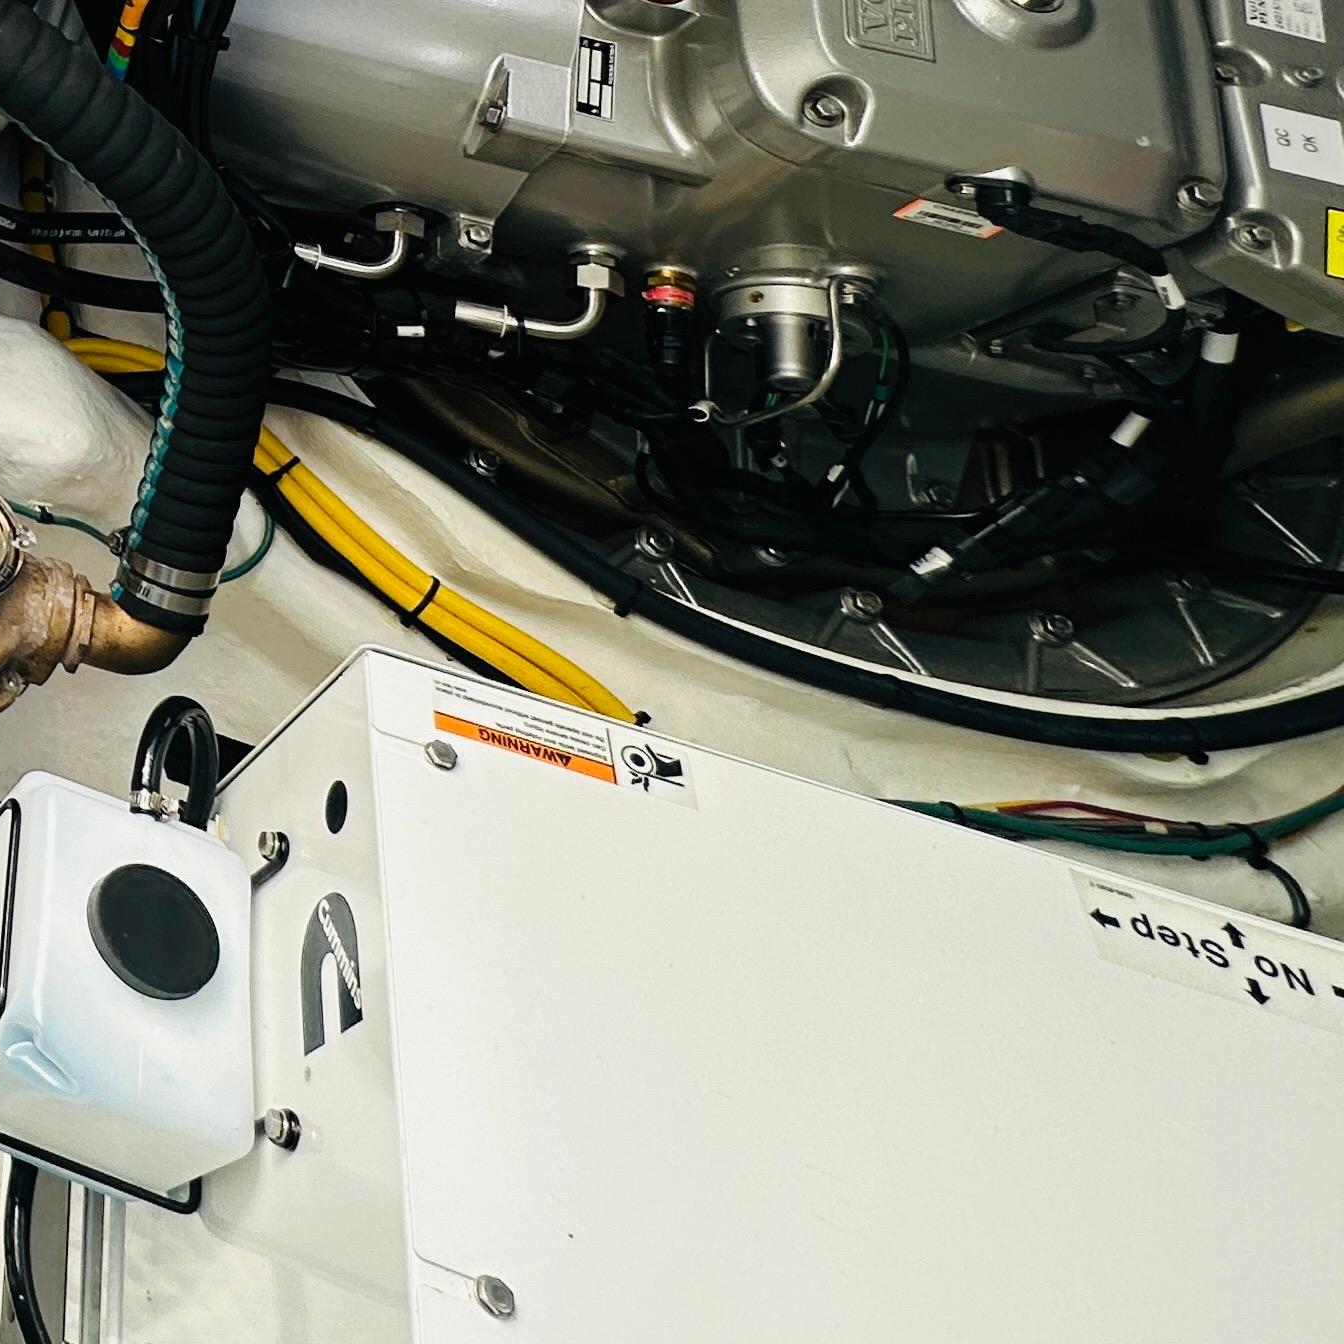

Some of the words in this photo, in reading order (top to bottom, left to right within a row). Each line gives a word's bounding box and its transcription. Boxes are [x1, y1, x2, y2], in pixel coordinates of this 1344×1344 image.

[1274, 127, 1291, 147] QC
[1301, 133, 1319, 153] OK
[477, 727, 559, 766] WARNING
[317, 898, 362, 1010] Cummins
[1129, 913, 1231, 969] Step
[1254, 955, 1316, 996] No
